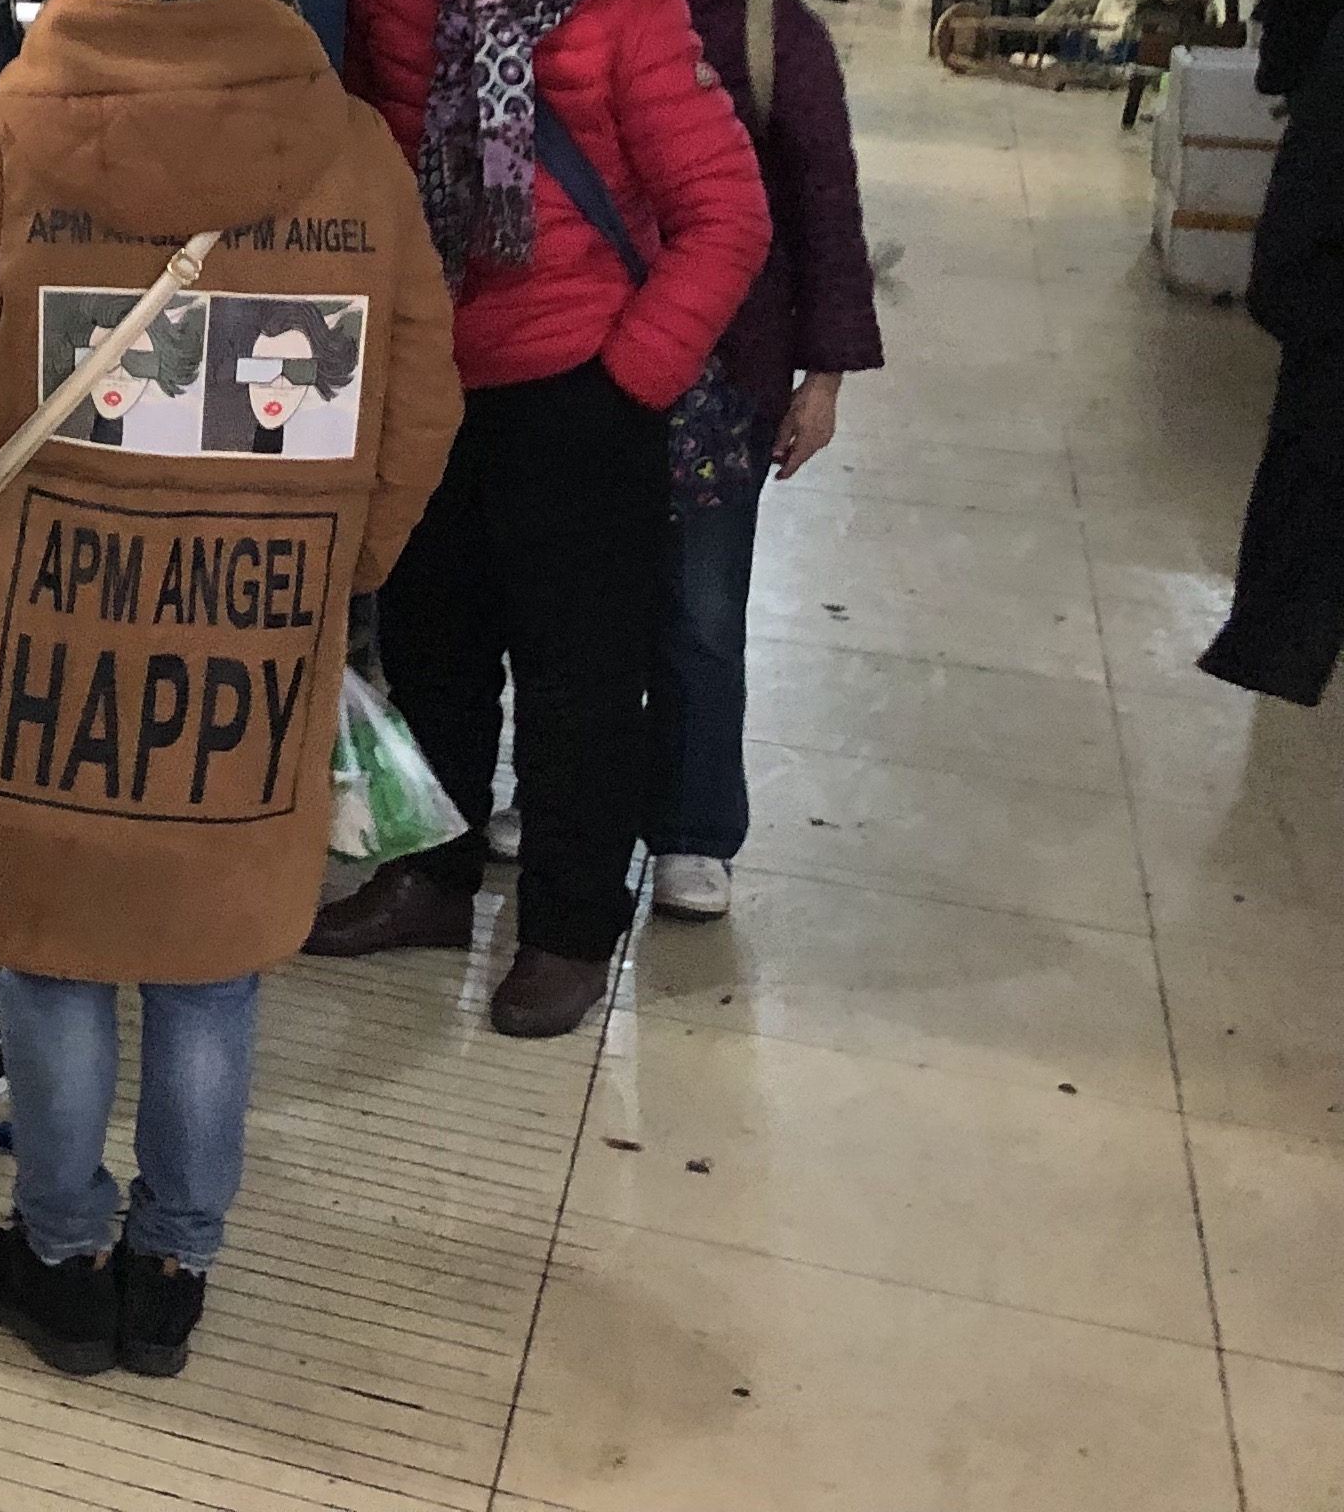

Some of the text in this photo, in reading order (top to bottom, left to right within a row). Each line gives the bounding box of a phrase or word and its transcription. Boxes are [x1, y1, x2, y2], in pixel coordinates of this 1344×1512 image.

[25, 207, 93, 245] APM
[284, 217, 377, 254] ANGEL
[28, 519, 315, 632] APM ANGEL
[0, 633, 307, 807] HAPPY
